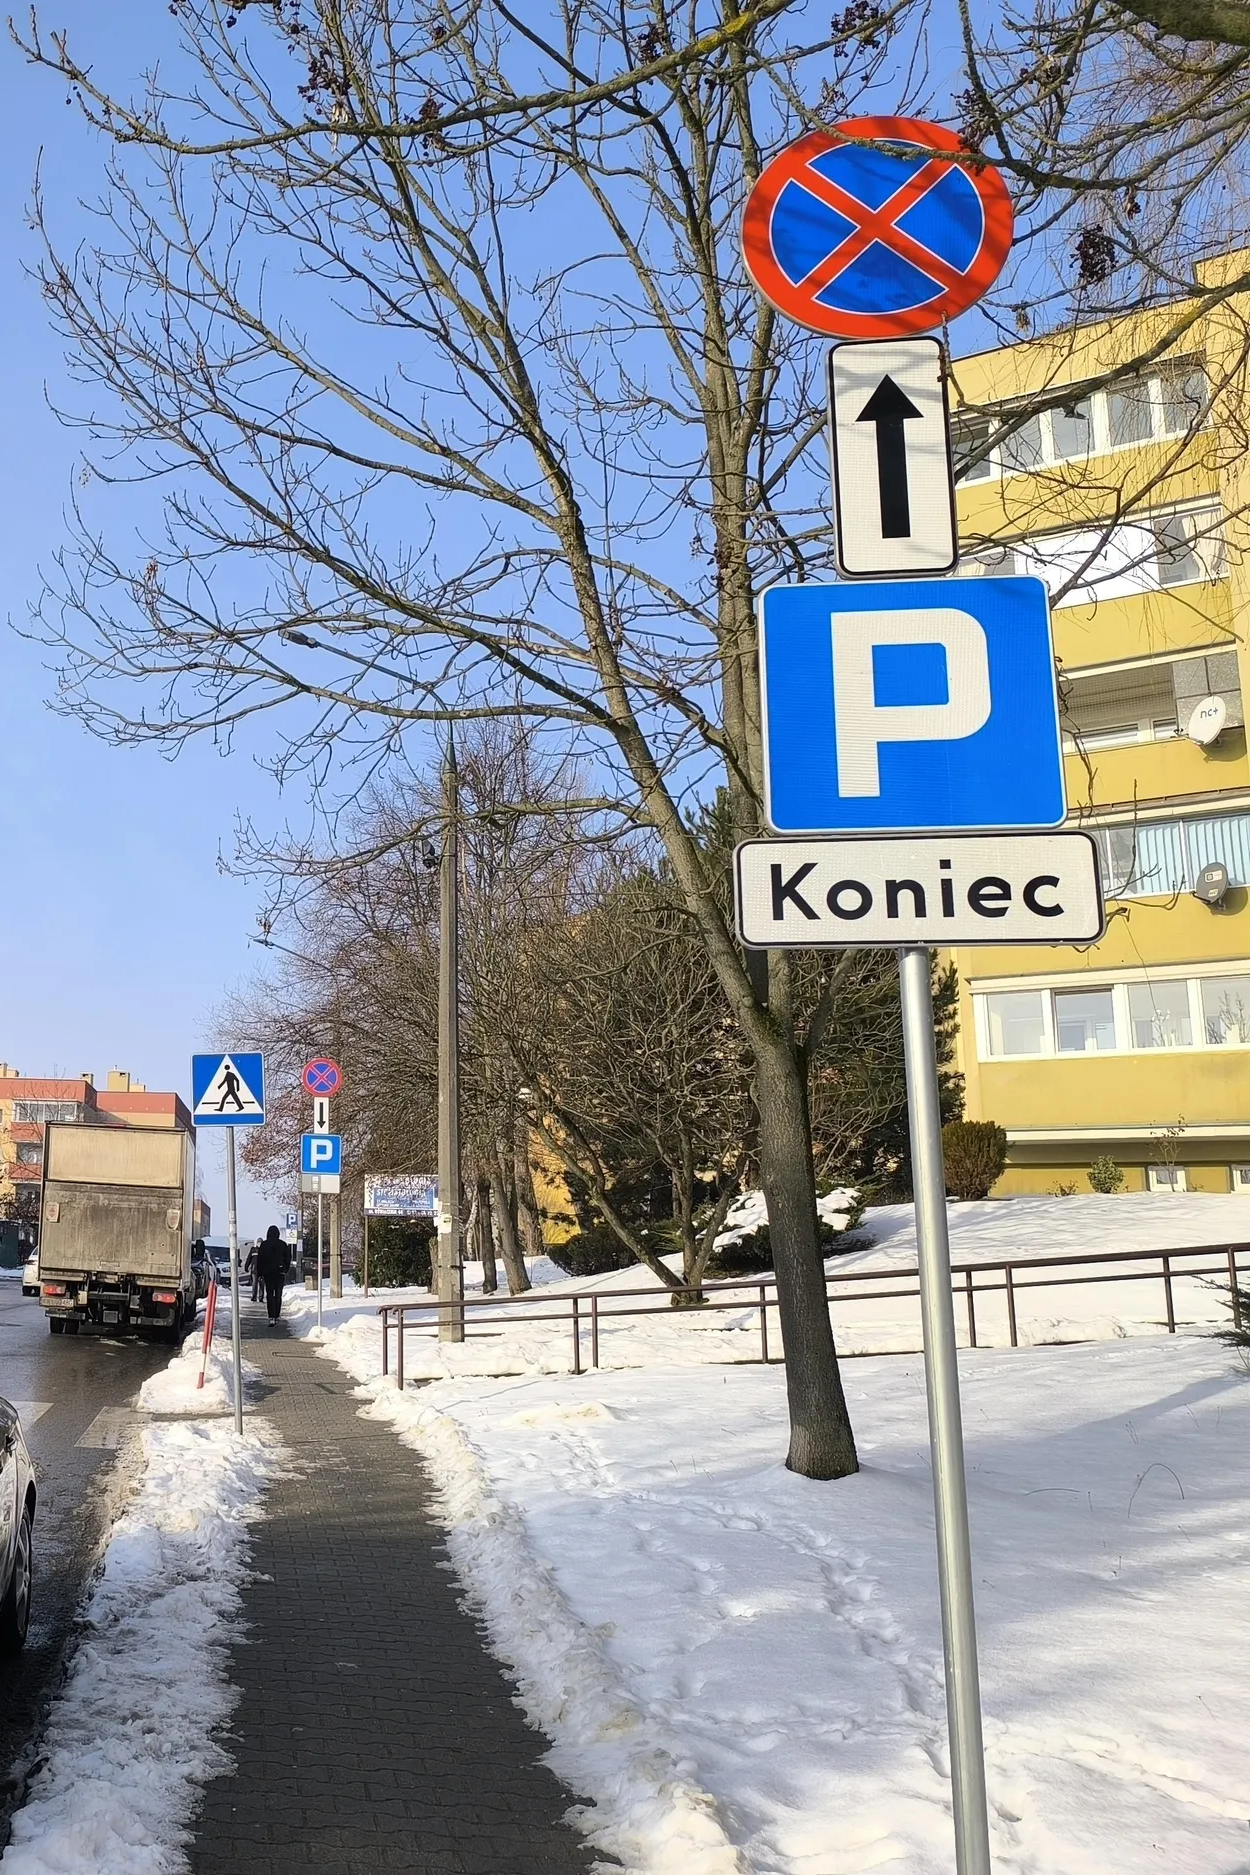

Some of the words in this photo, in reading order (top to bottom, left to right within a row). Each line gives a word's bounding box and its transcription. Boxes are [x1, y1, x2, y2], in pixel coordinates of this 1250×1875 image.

[831, 607, 992, 798] P
[1200, 706, 1218, 718] nc+
[770, 859, 1065, 920] Koniec
[310, 1138, 333, 1169] P
[288, 1214, 296, 1225] P
